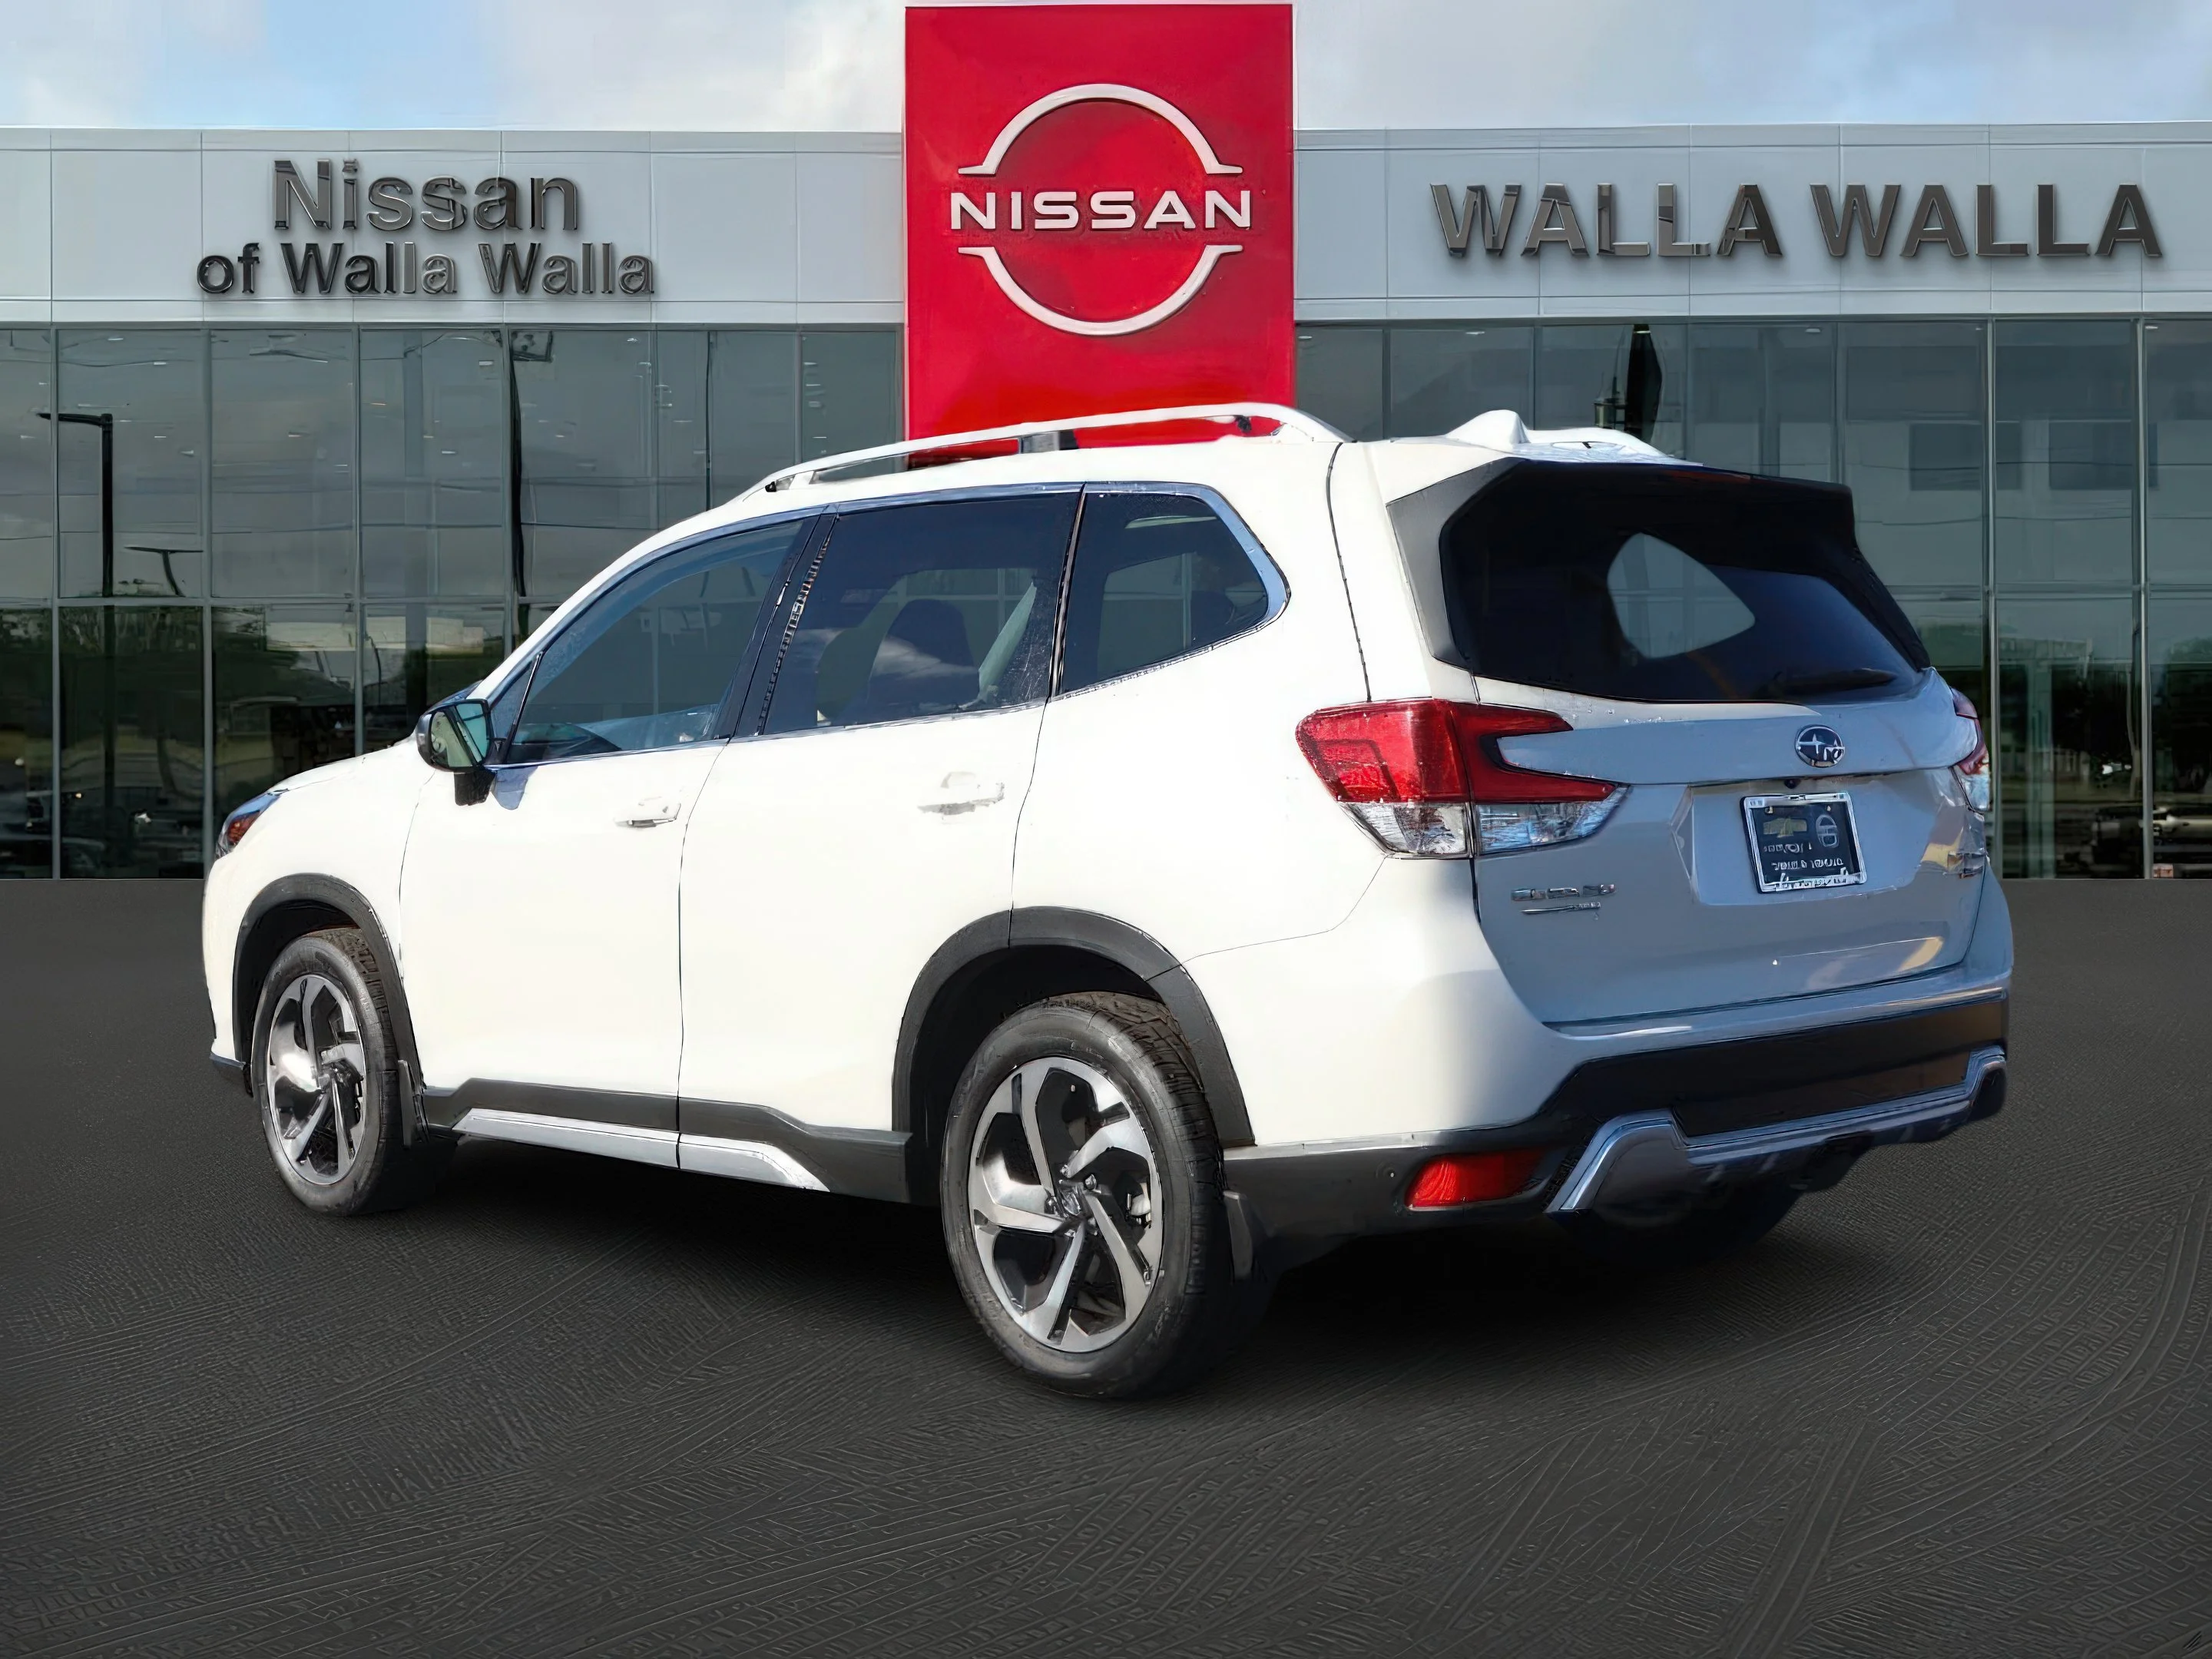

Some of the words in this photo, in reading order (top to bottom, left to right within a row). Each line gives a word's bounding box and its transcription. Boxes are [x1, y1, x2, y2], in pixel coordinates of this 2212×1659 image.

[273, 159, 580, 230] Nissan
[950, 190, 1251, 230] NISSAN
[1429, 183, 1783, 259] WALLA
[1809, 183, 2163, 259] WALLA
[197, 242, 261, 294] of
[280, 241, 460, 295] Walla
[477, 241, 656, 295] Walla
